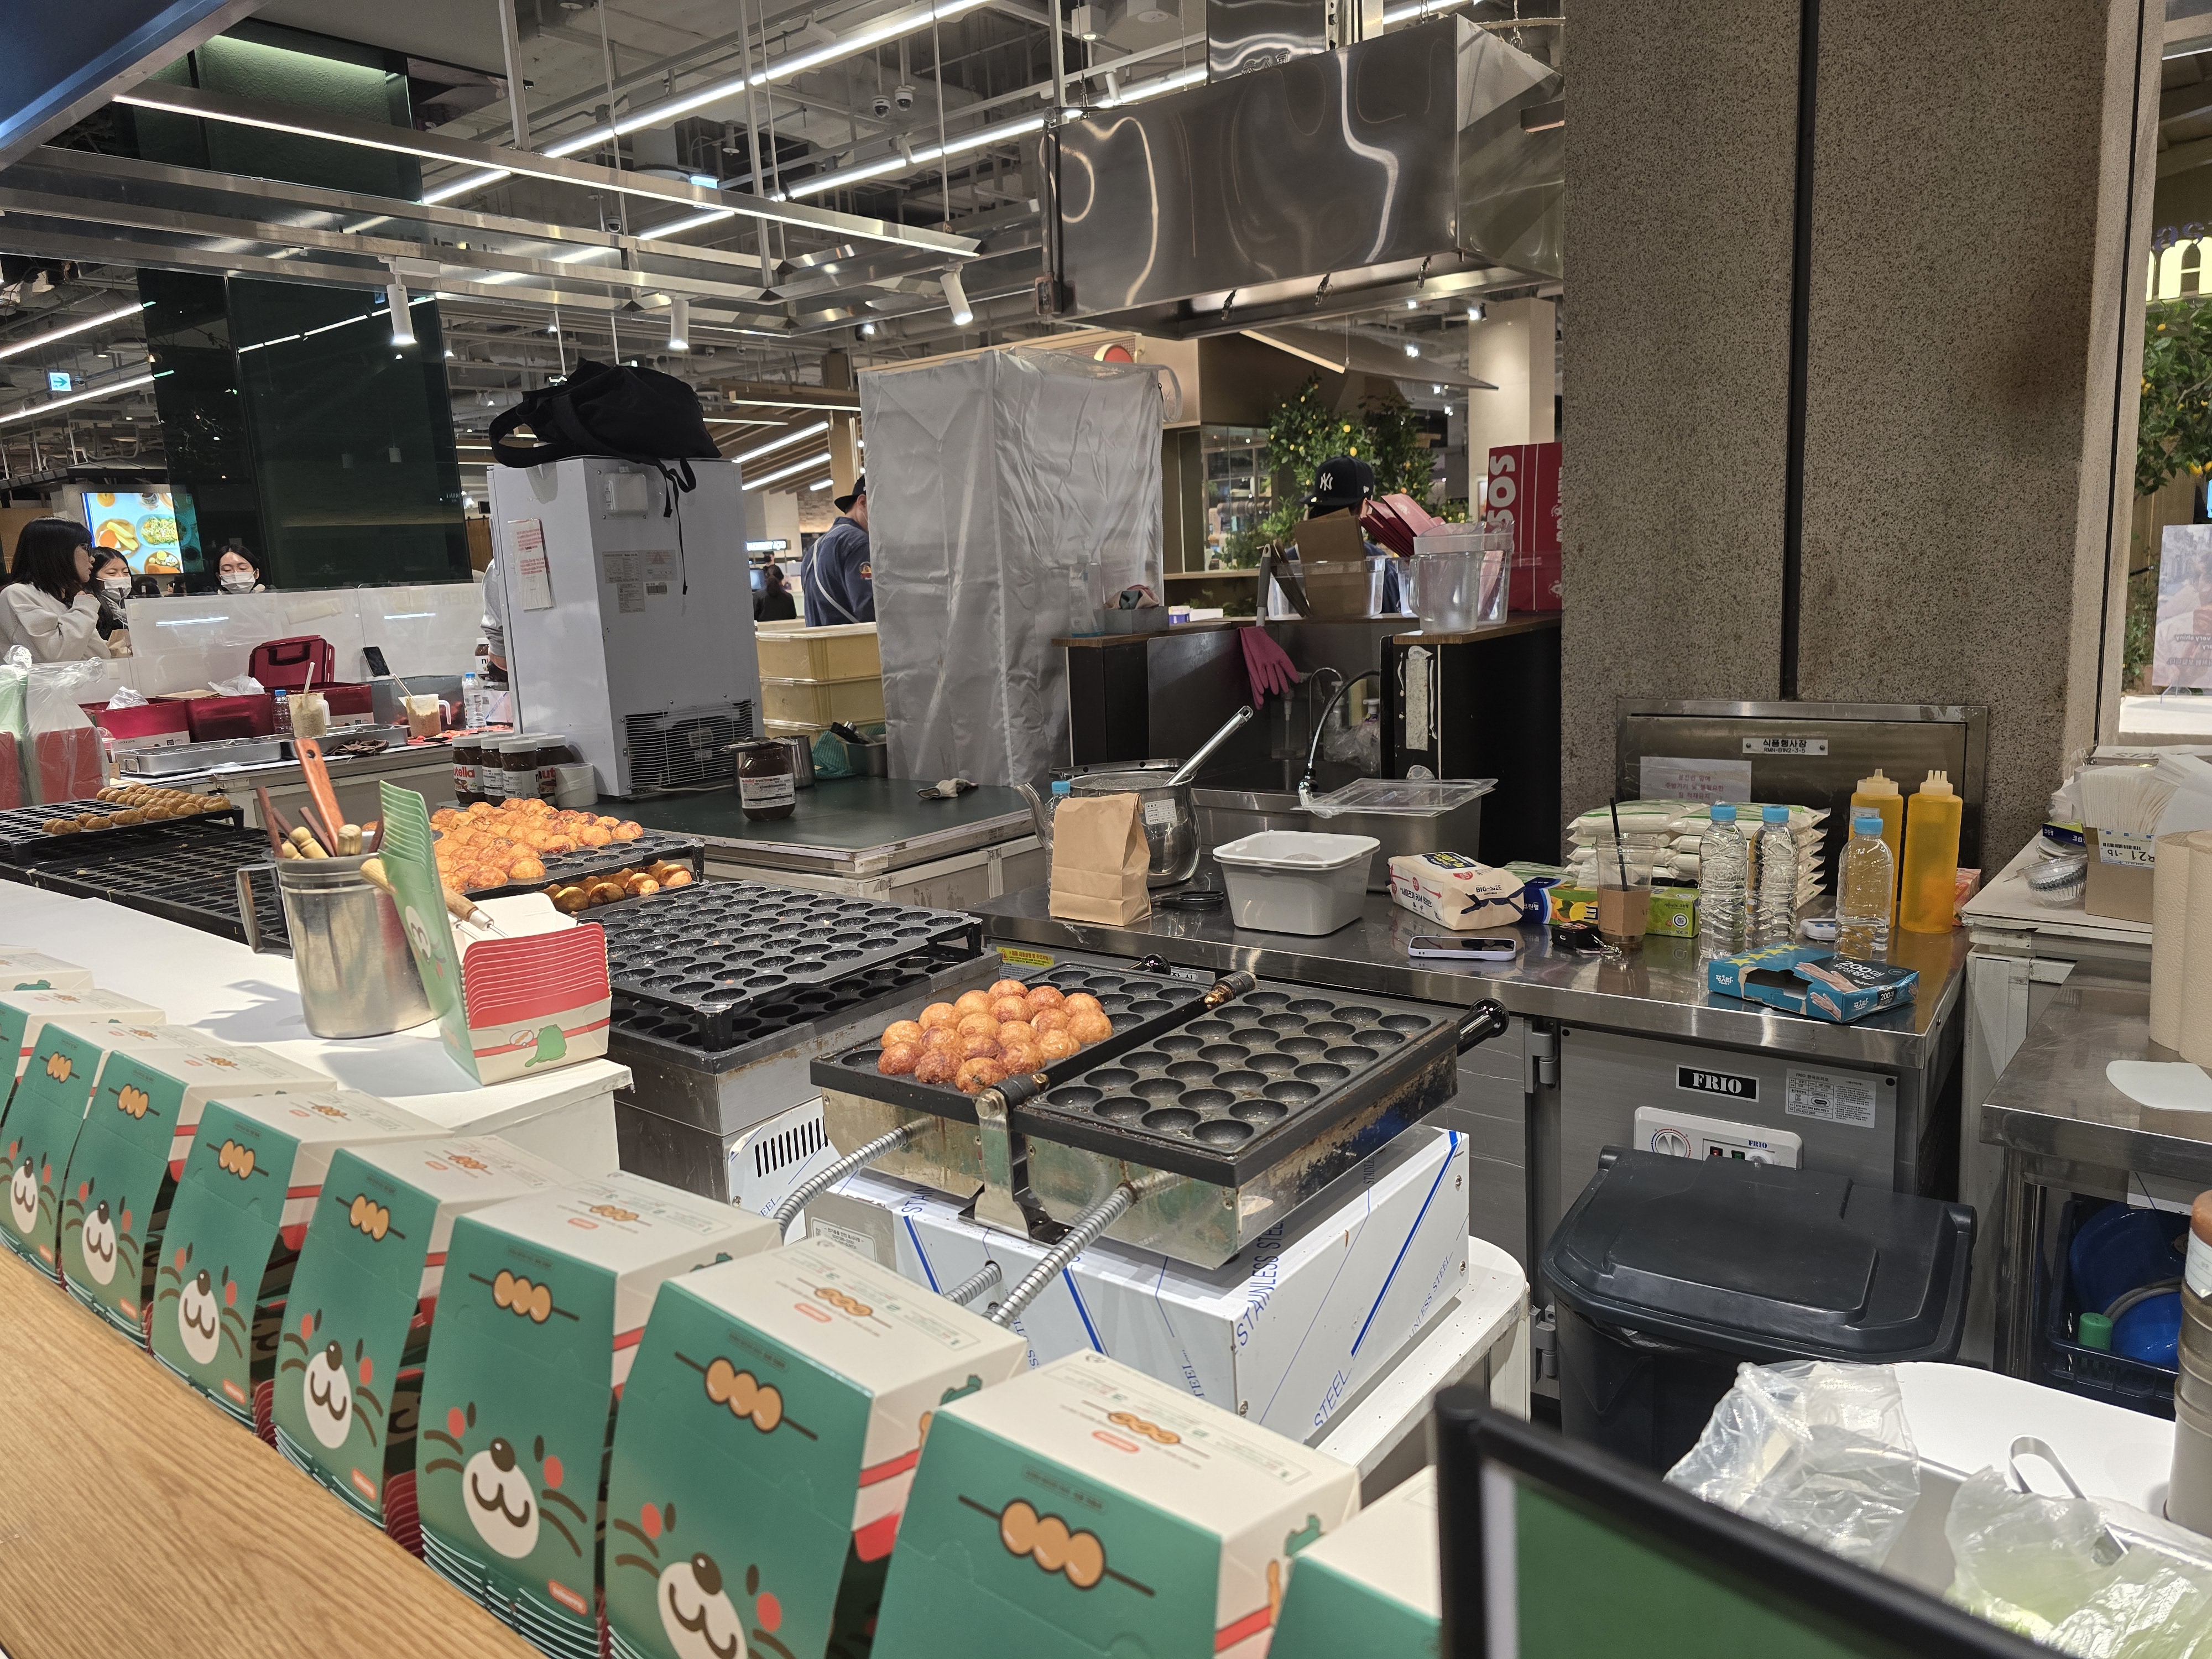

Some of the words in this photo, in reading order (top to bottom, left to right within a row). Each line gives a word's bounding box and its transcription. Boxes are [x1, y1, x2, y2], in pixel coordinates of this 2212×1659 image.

[2151, 219, 2212, 252] as
[1319, 472, 1333, 491] NY
[1763, 738, 1807, 748] 식품행사장
[453, 766, 476, 778] utella
[1839, 961, 1884, 978] 200매
[1692, 1072, 1742, 1094] FRIO
[1748, 1140, 1768, 1149] FRIO
[1363, 1157, 1375, 1185] STAINLE
[760, 1198, 776, 1217] EEL
[901, 1186, 936, 1213] STAIN
[1256, 1221, 1284, 1249] STE
[1237, 1255, 1279, 1346] STAINLESS
[1409, 1293, 1432, 1338] INLESS
[1432, 1251, 1453, 1292] STEEL
[1181, 1365, 1204, 1397] TEEL
[1314, 1369, 1349, 1427] STEEL
